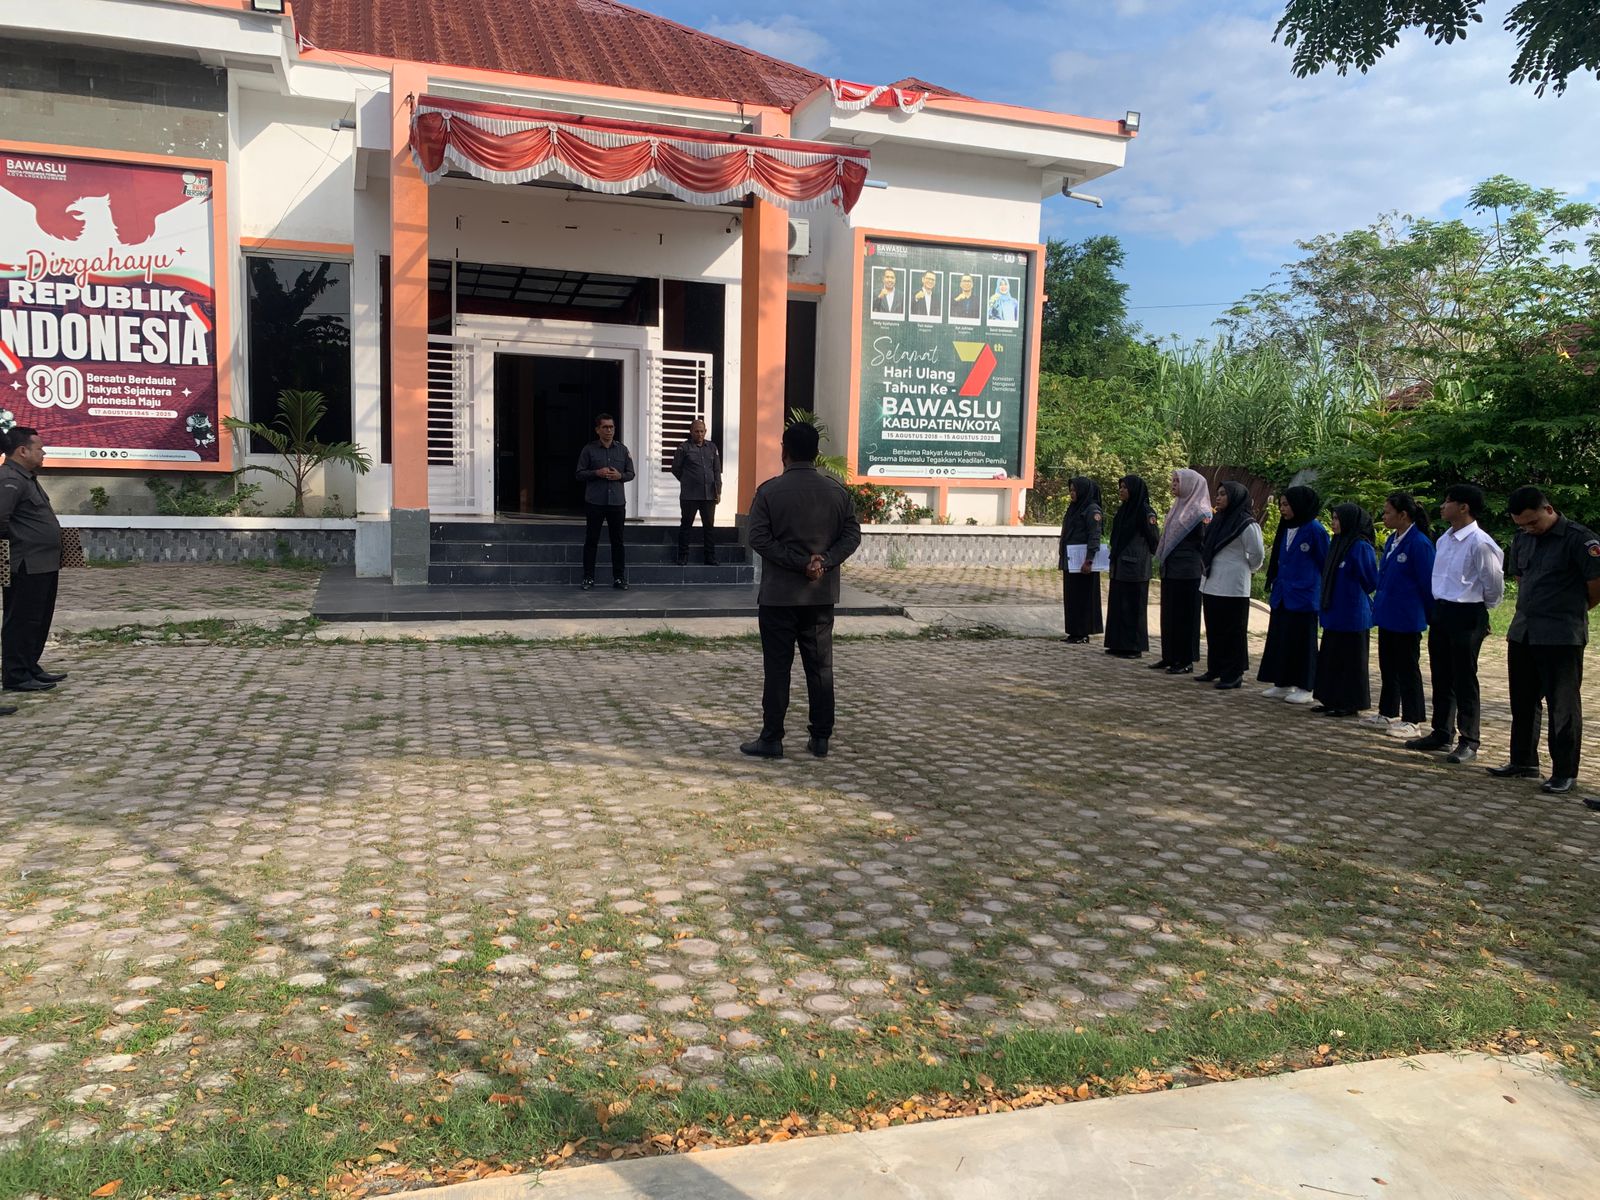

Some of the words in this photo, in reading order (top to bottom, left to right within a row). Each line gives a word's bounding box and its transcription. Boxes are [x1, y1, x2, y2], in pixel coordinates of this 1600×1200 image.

[6, 158, 67, 174] BAWASLU
[876, 244, 908, 253] BAWASLU
[27, 247, 173, 288] Dirgahayu
[8, 280, 187, 312] REPUBLIK
[870, 336, 938, 366] Selamat
[993, 343, 1004, 353] th
[86, 373, 126, 384] Bersatu
[128, 375, 177, 386] Berdaulat
[884, 366, 912, 379] Hari
[916, 367, 956, 383] Ulang
[26, 364, 84, 410] 80
[87, 384, 122, 396] Rakyat
[124, 386, 172, 397] Sejahtera
[883, 382, 926, 395] Tahun
[930, 383, 949, 395] Ke
[87, 395, 137, 406] Indonesia
[138, 397, 161, 409] Maju
[882, 396, 1002, 419] BAWASLU
[882, 417, 1002, 432] KABUPATEN/KOTA
[895, 432, 923, 440] AGUSTUS
[892, 448, 921, 456] Bersama
[921, 449, 943, 458] Rakyat
[944, 450, 963, 458] Awasi
[963, 450, 986, 458] Pemilu
[869, 455, 898, 463] Bersama
[899, 456, 926, 464] Bawaslu
[926, 456, 956, 466] Tegakkan
[958, 457, 985, 465] Keadilan
[985, 458, 1007, 466] Pemilu
